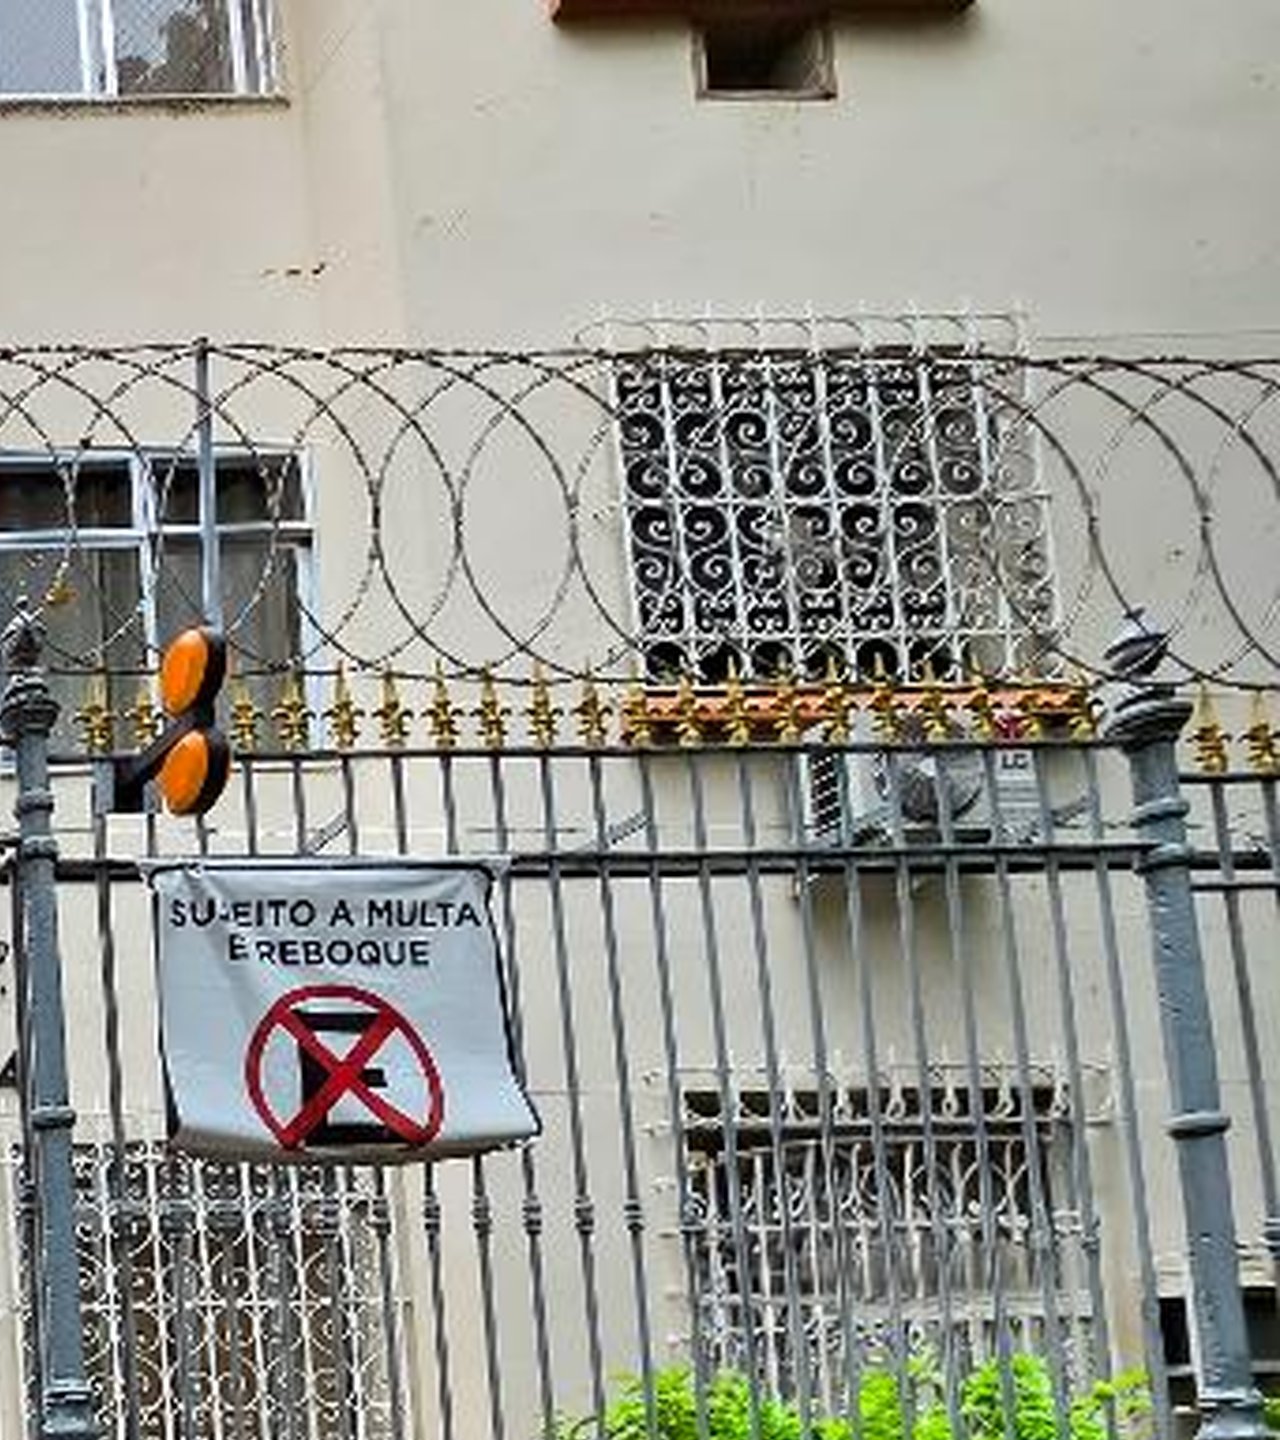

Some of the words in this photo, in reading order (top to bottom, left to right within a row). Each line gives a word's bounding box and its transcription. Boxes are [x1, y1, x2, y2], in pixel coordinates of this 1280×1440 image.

[329, 900, 355, 927] A
[367, 899, 482, 928] MULTA
[255, 938, 431, 967] REBOQUE
